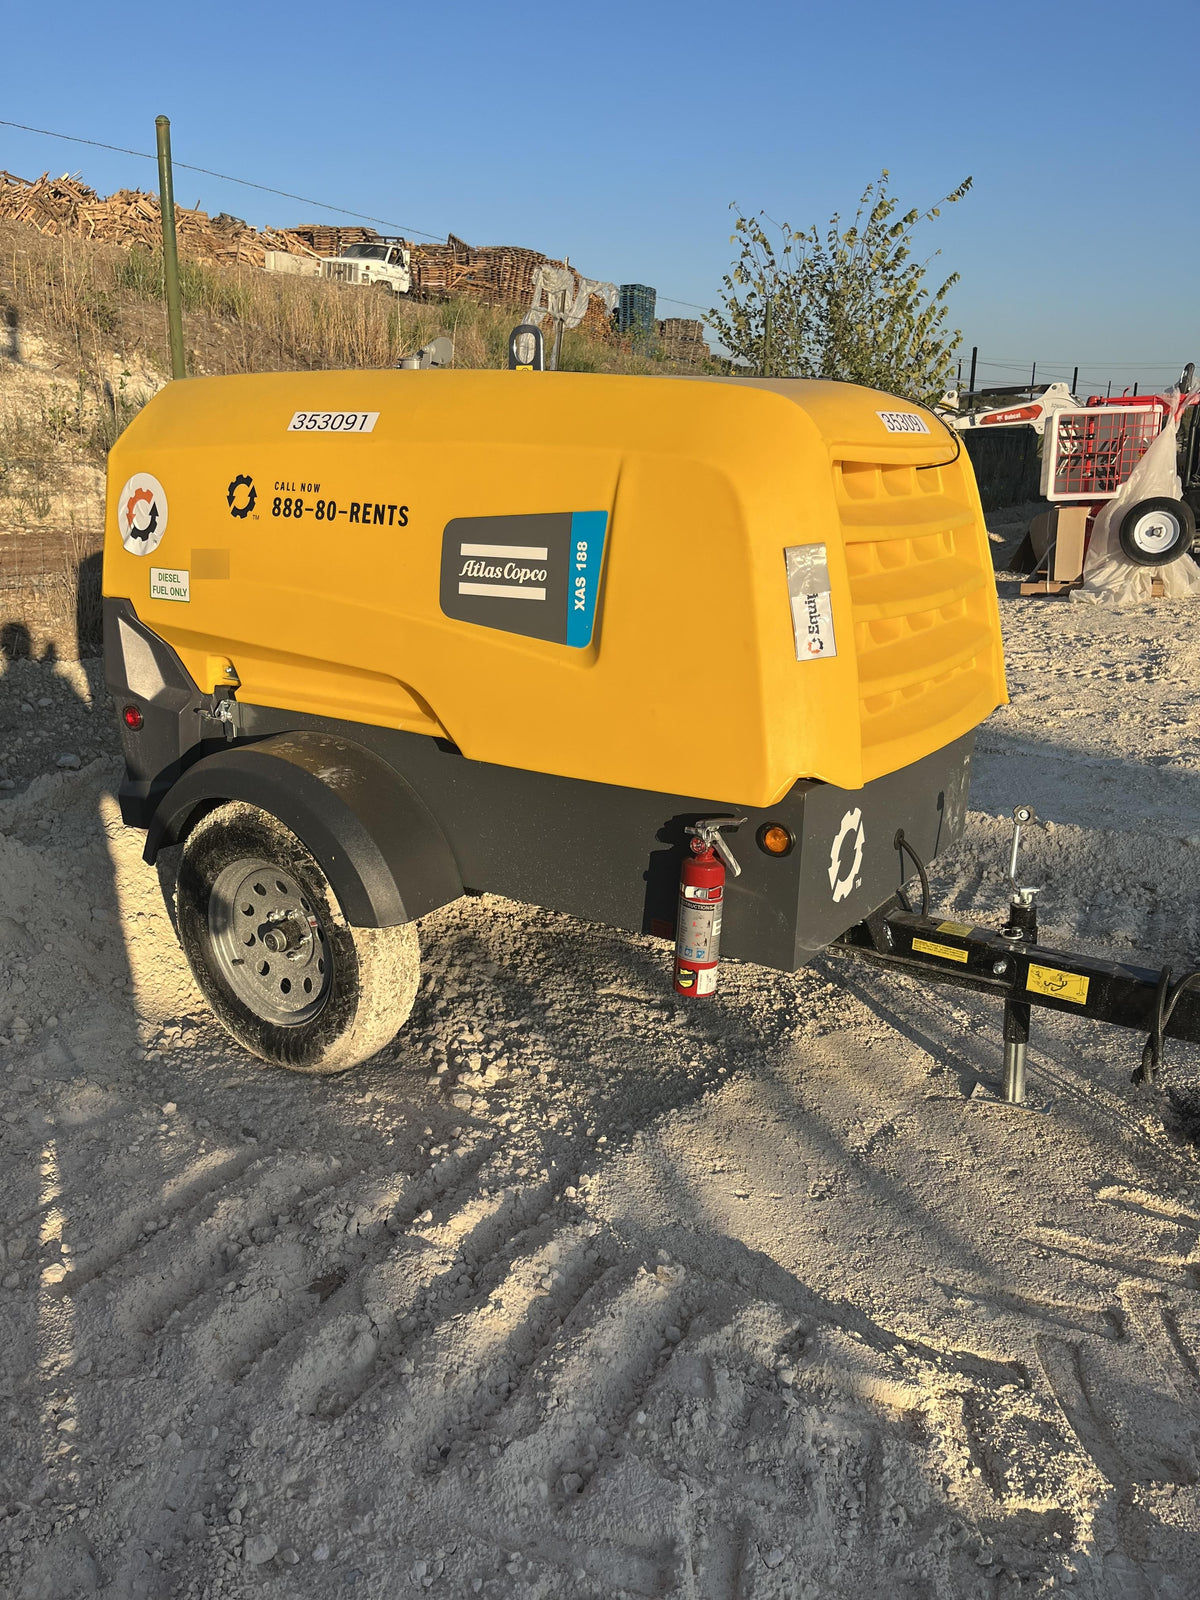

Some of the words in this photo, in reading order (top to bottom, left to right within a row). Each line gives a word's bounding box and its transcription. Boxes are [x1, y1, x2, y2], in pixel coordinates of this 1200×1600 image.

[292, 413, 368, 431] 353091
[881, 413, 927, 432] 353091
[274, 481, 296, 492] CALL
[300, 482, 321, 493] NOW
[271, 496, 409, 527] 888-80-RENTS
[575, 541, 588, 571] 188
[158, 572, 181, 583] DIESEL
[458, 559, 502, 579] Atlas
[503, 562, 548, 584] Copco
[152, 585, 168, 595] FUEL
[169, 586, 188, 597] ONLY
[574, 576, 587, 611] XAS
